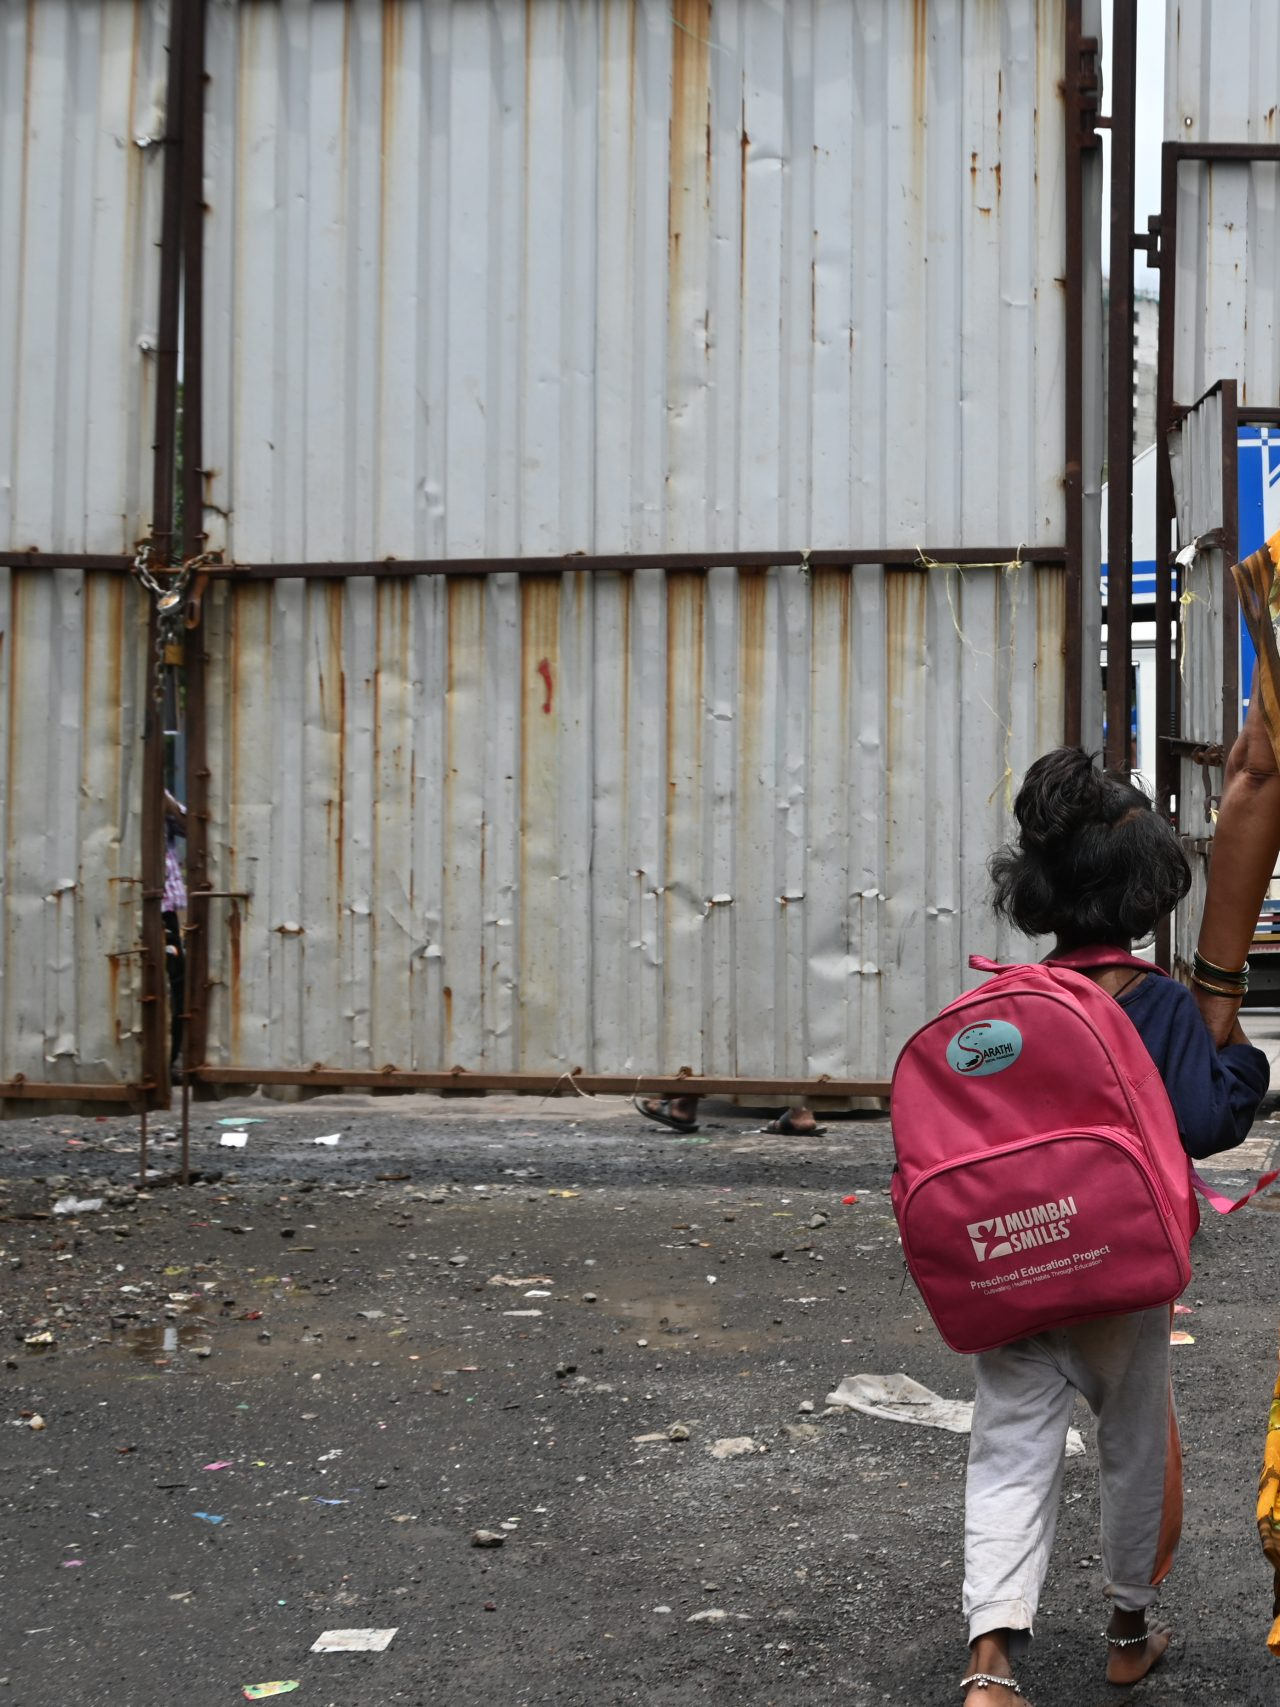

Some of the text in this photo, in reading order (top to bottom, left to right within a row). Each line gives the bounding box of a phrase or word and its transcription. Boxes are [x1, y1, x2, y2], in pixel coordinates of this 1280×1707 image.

[1005, 1196, 1077, 1233] MUMBAI
[1010, 1219, 1071, 1252] SMILES
[970, 1245, 1110, 1290] Preschool Education Project
[1051, 1267, 1074, 1278] Through
[1074, 1258, 1103, 1271] Education
